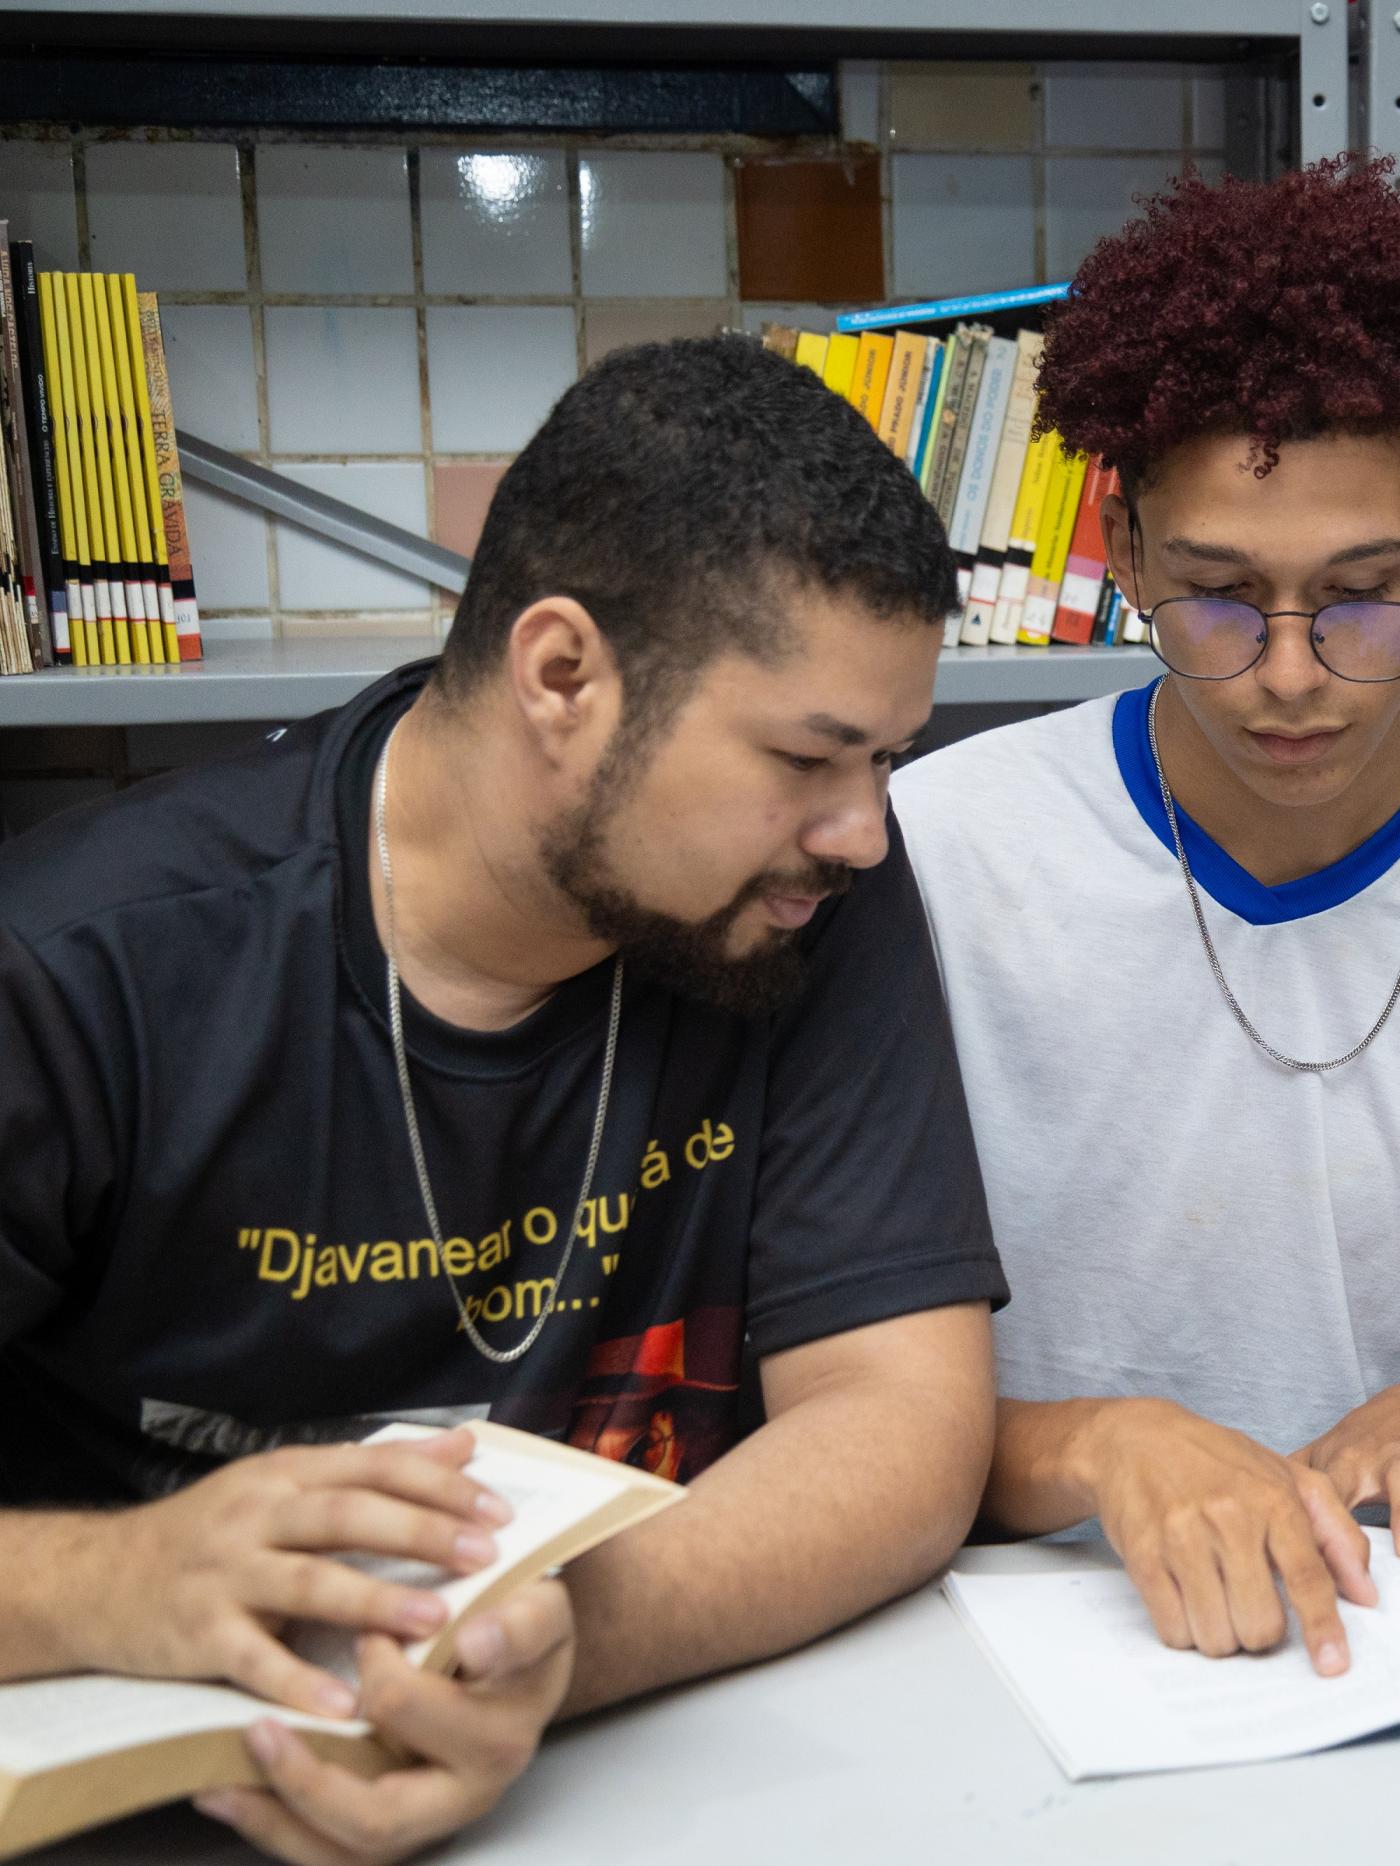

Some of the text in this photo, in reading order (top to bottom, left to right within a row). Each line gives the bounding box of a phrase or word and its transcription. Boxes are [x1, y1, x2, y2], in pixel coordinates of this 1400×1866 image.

[151, 410, 171, 466] TERRA
[522, 1206, 558, 1246] o
[575, 1192, 630, 1249] qu
[640, 1139, 671, 1190] á
[684, 1118, 736, 1170] de
